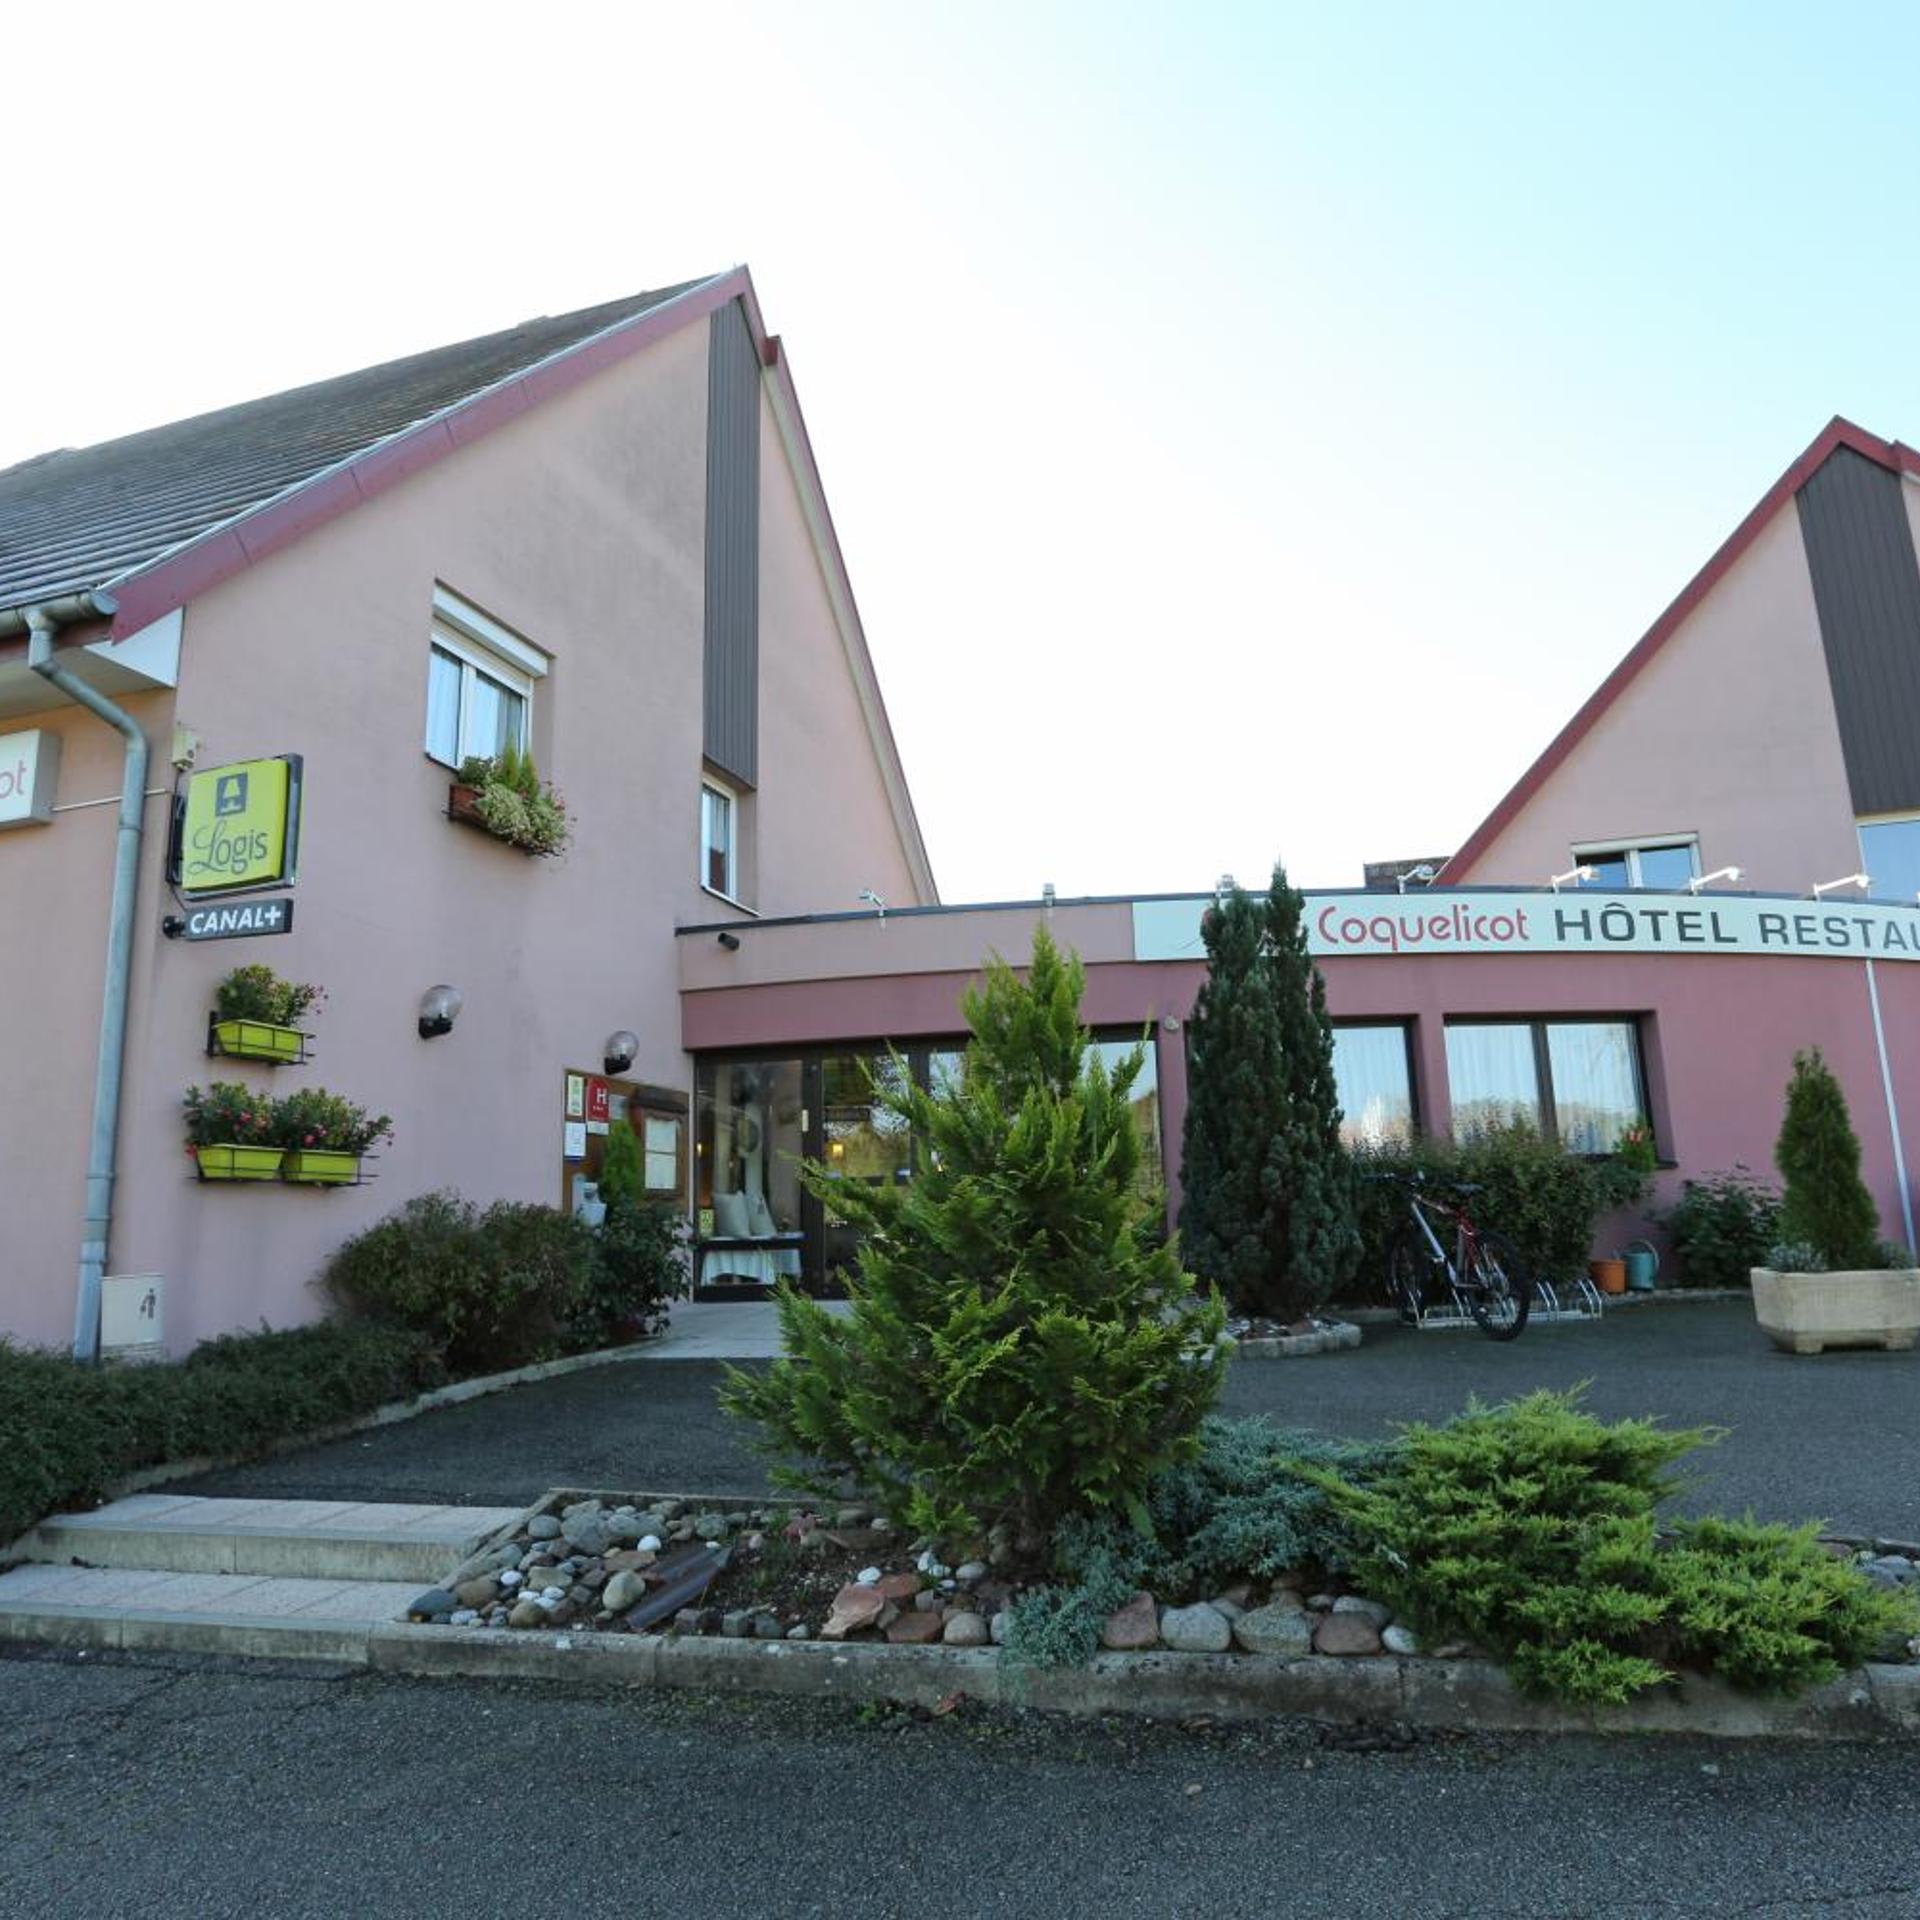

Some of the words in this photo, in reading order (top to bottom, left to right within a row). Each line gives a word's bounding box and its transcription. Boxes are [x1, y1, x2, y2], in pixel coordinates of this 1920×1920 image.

[189, 820, 269, 875] Logis
[190, 905, 281, 934] CANAL+
[1318, 904, 1529, 951] Coquelicot
[1555, 902, 1738, 944] HÔTEL
[596, 1087, 608, 1104] H
